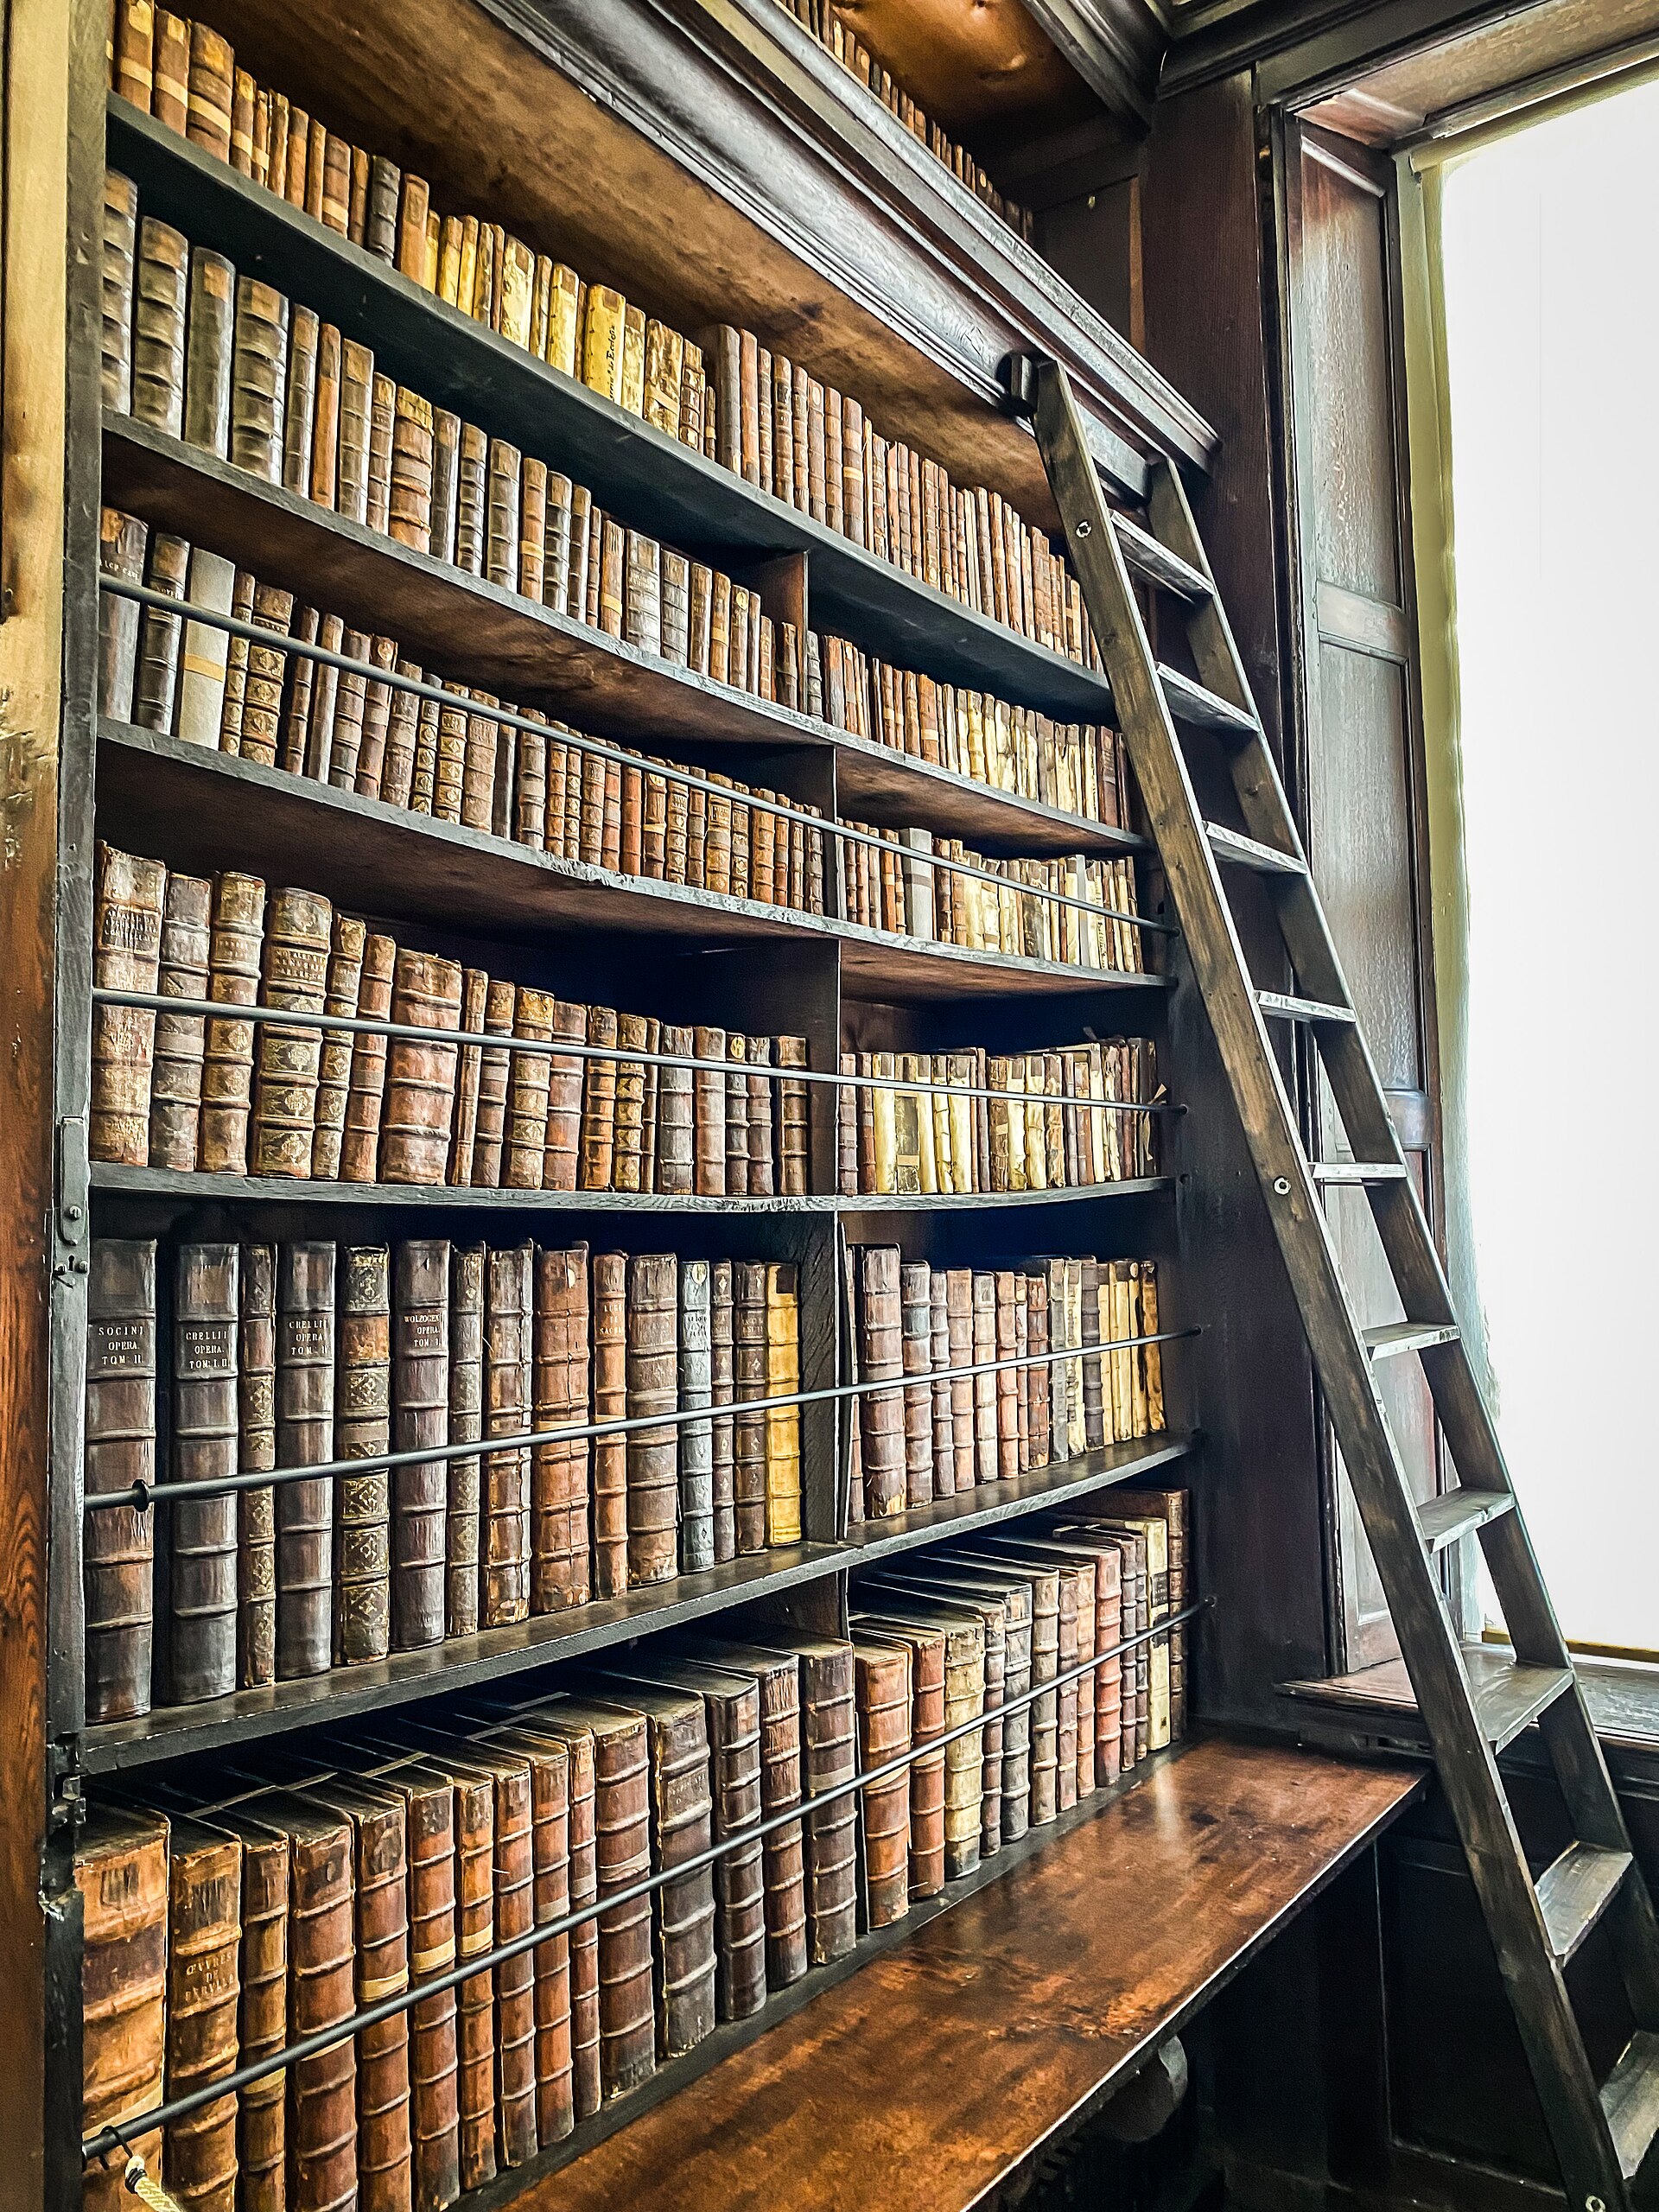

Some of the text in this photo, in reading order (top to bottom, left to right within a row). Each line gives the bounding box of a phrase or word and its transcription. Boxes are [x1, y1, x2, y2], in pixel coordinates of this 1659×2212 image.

[289, 1319, 328, 1329] CRELLII
[99, 1325, 143, 1336] SOCINI
[186, 1331, 227, 1341] CRELLII
[194, 1344, 225, 1355] OPERA.
